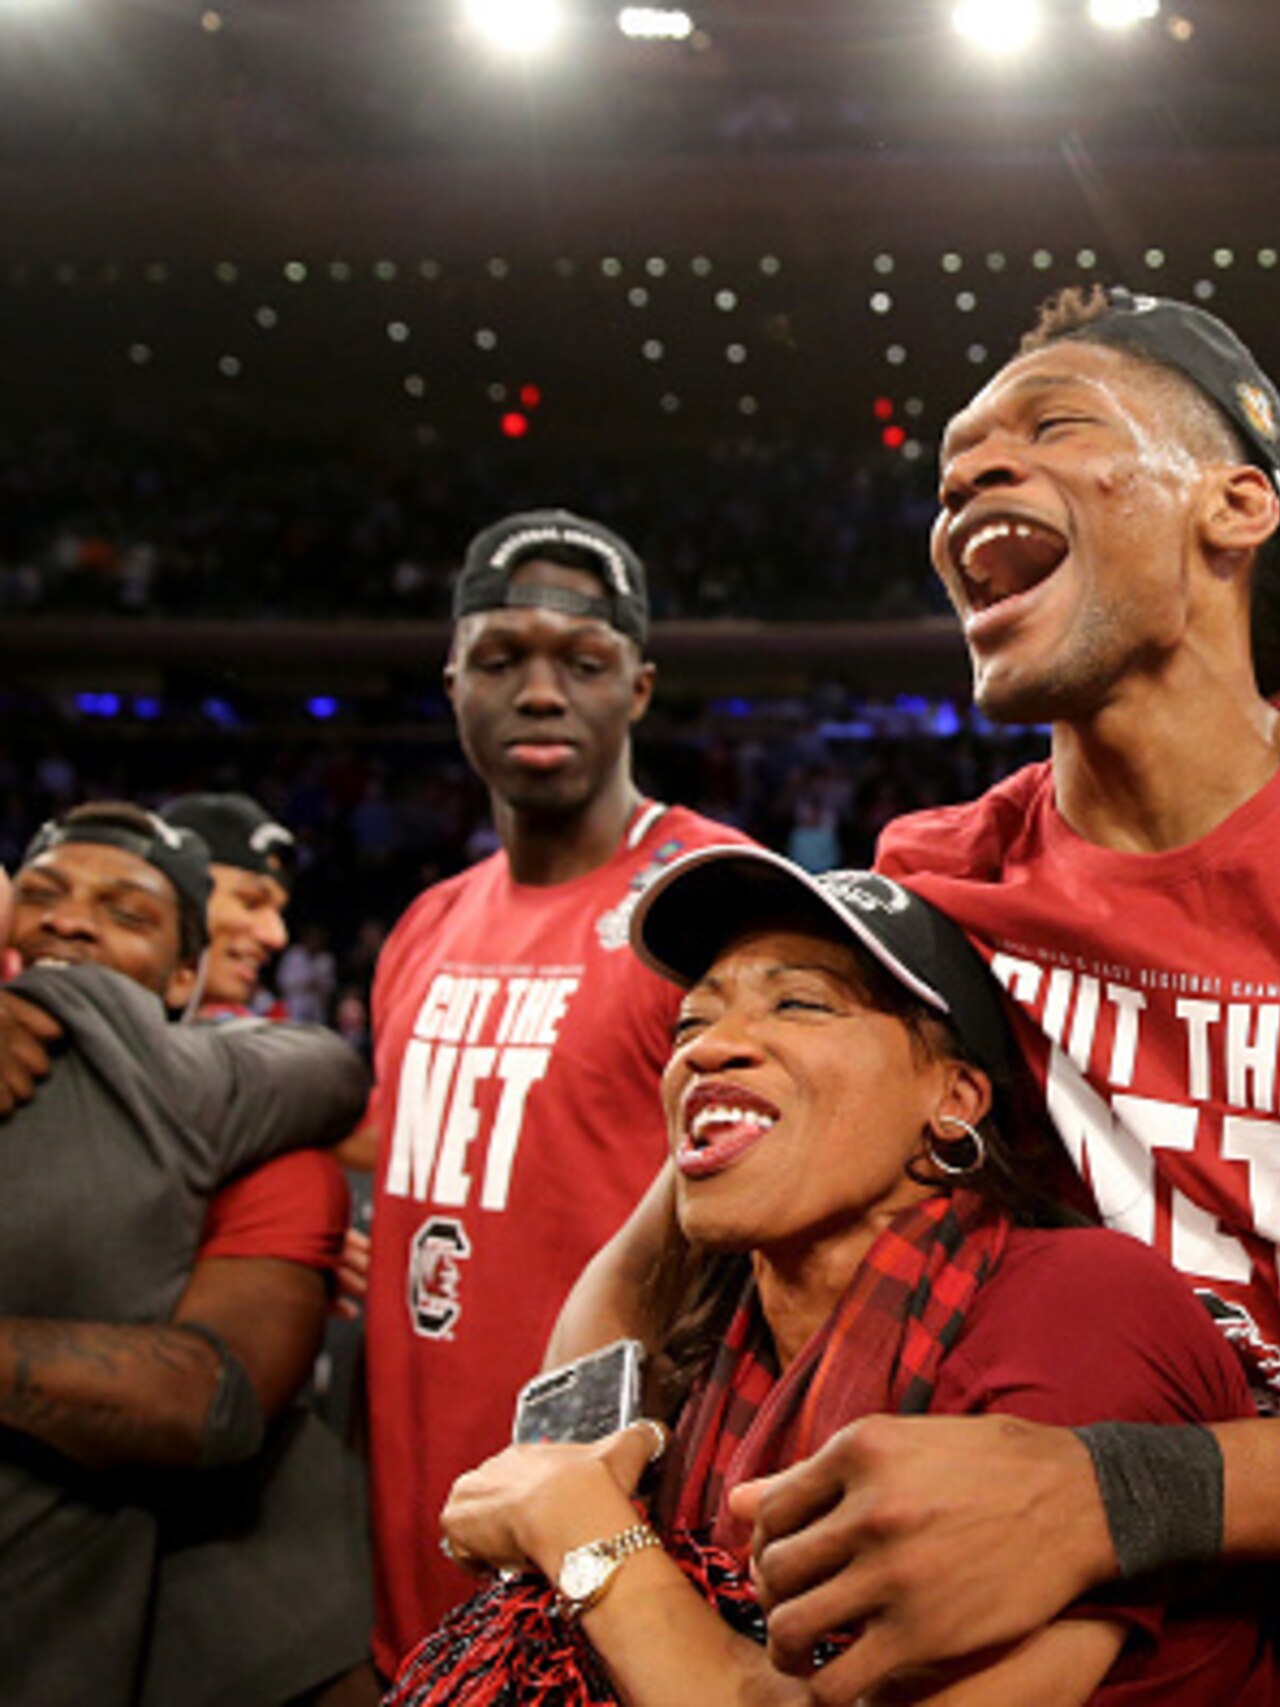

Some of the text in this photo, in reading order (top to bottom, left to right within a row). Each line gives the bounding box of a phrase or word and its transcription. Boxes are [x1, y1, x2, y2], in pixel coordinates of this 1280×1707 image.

[413, 973, 579, 1046] CUT THE
[386, 1039, 551, 1212] NET
